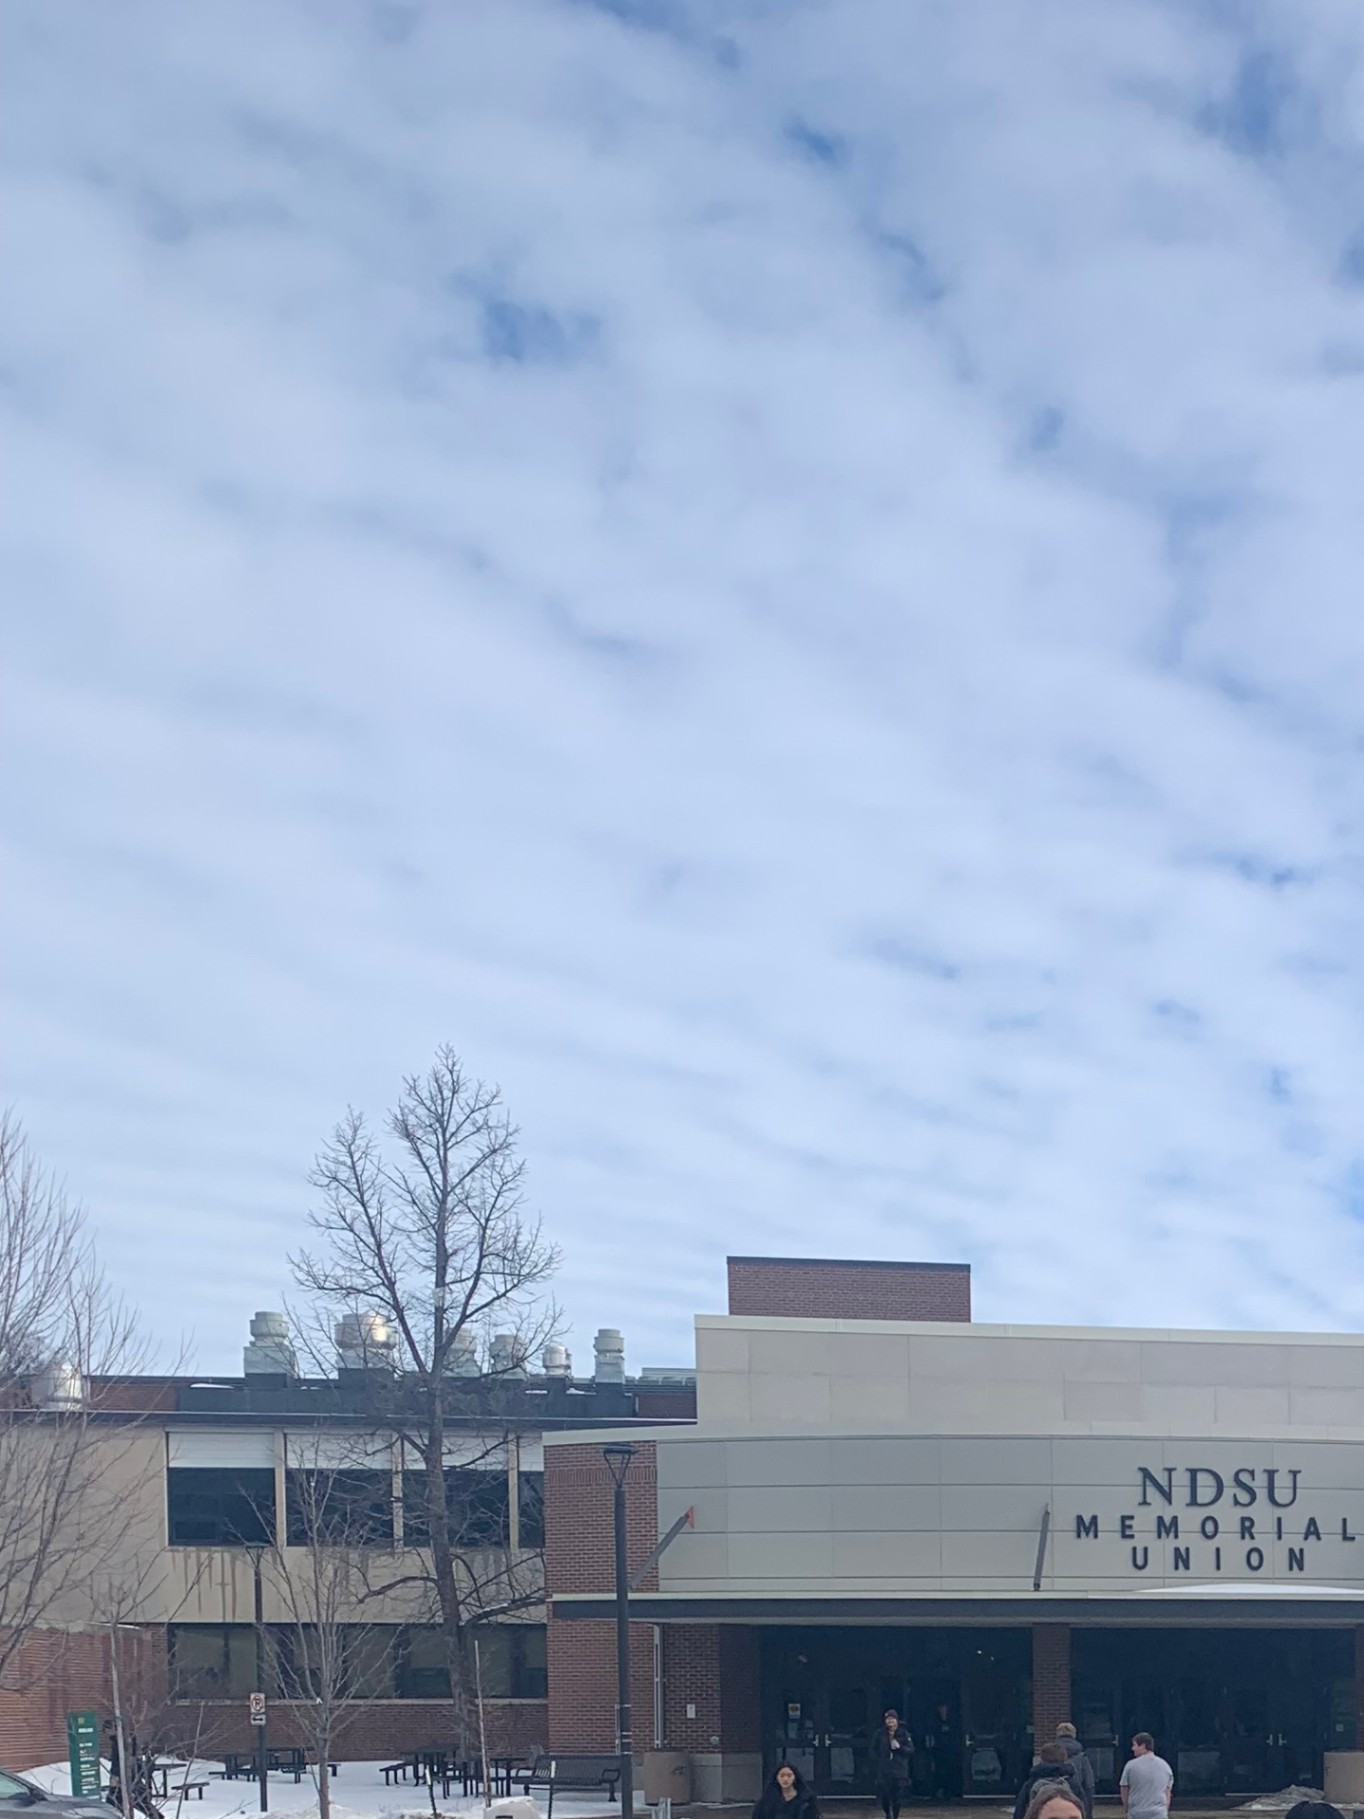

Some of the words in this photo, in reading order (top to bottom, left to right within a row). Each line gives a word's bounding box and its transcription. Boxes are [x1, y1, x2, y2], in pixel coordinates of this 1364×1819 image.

[1137, 1467, 1302, 1507] NDSU
[1075, 1514, 1356, 1541] MEMORIAL
[1131, 1546, 1305, 1572] UNION
